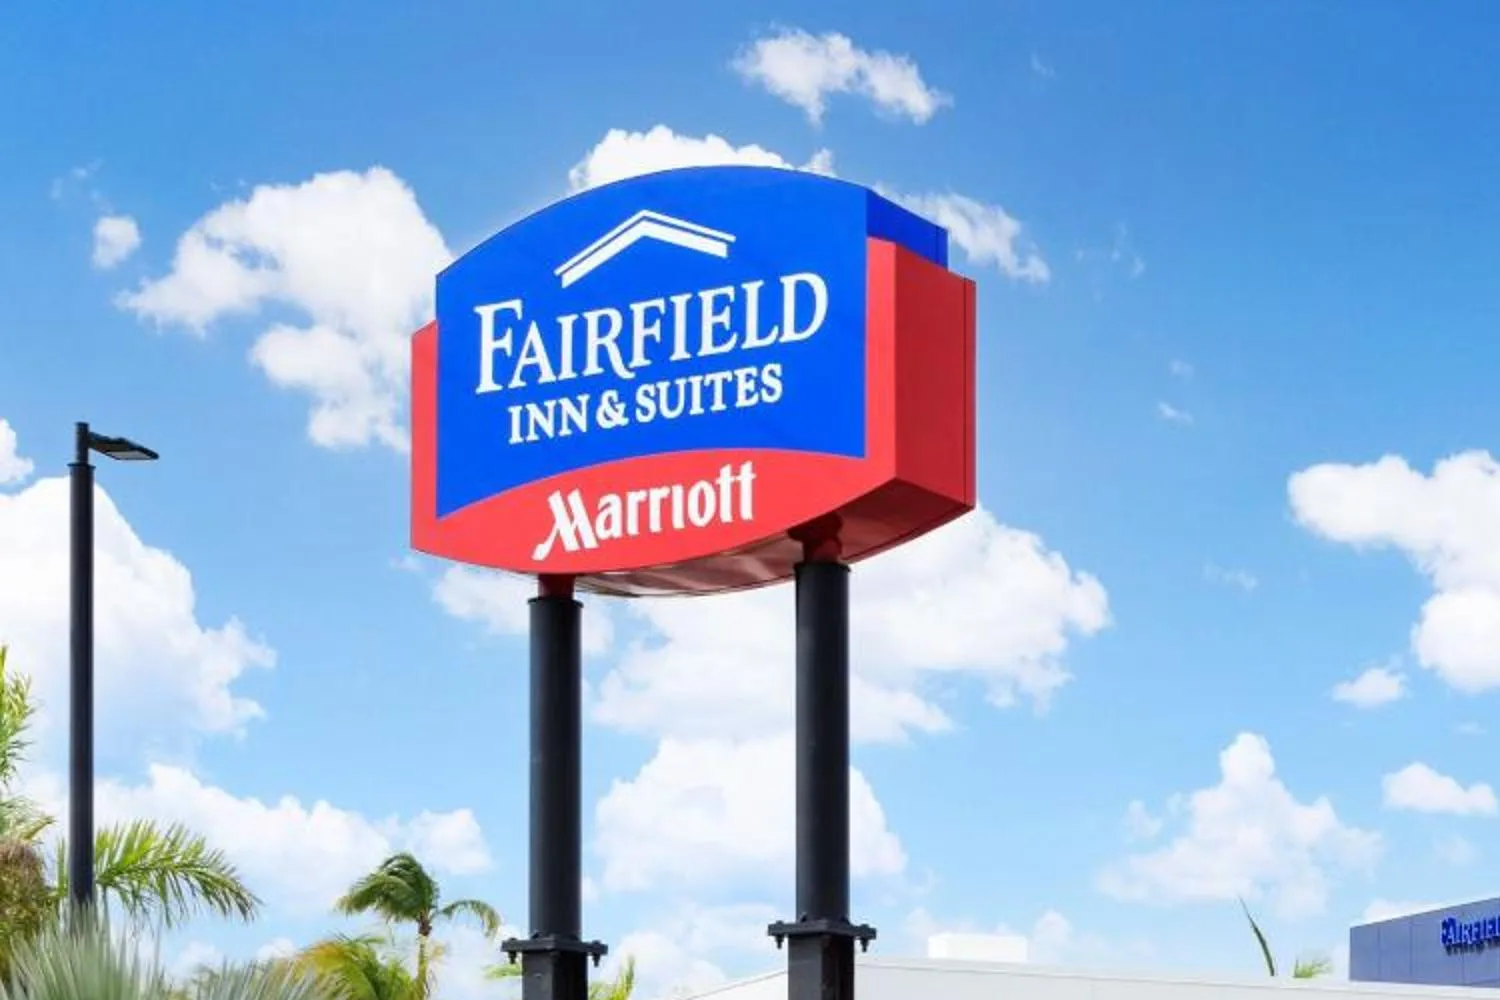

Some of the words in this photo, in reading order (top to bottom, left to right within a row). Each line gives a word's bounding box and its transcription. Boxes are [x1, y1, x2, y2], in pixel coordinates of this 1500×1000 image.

[473, 271, 829, 395] FAIRFIELD
[507, 393, 592, 445] INN
[595, 389, 629, 430] &
[634, 362, 784, 424] SUITES
[531, 460, 757, 562] Marriott
